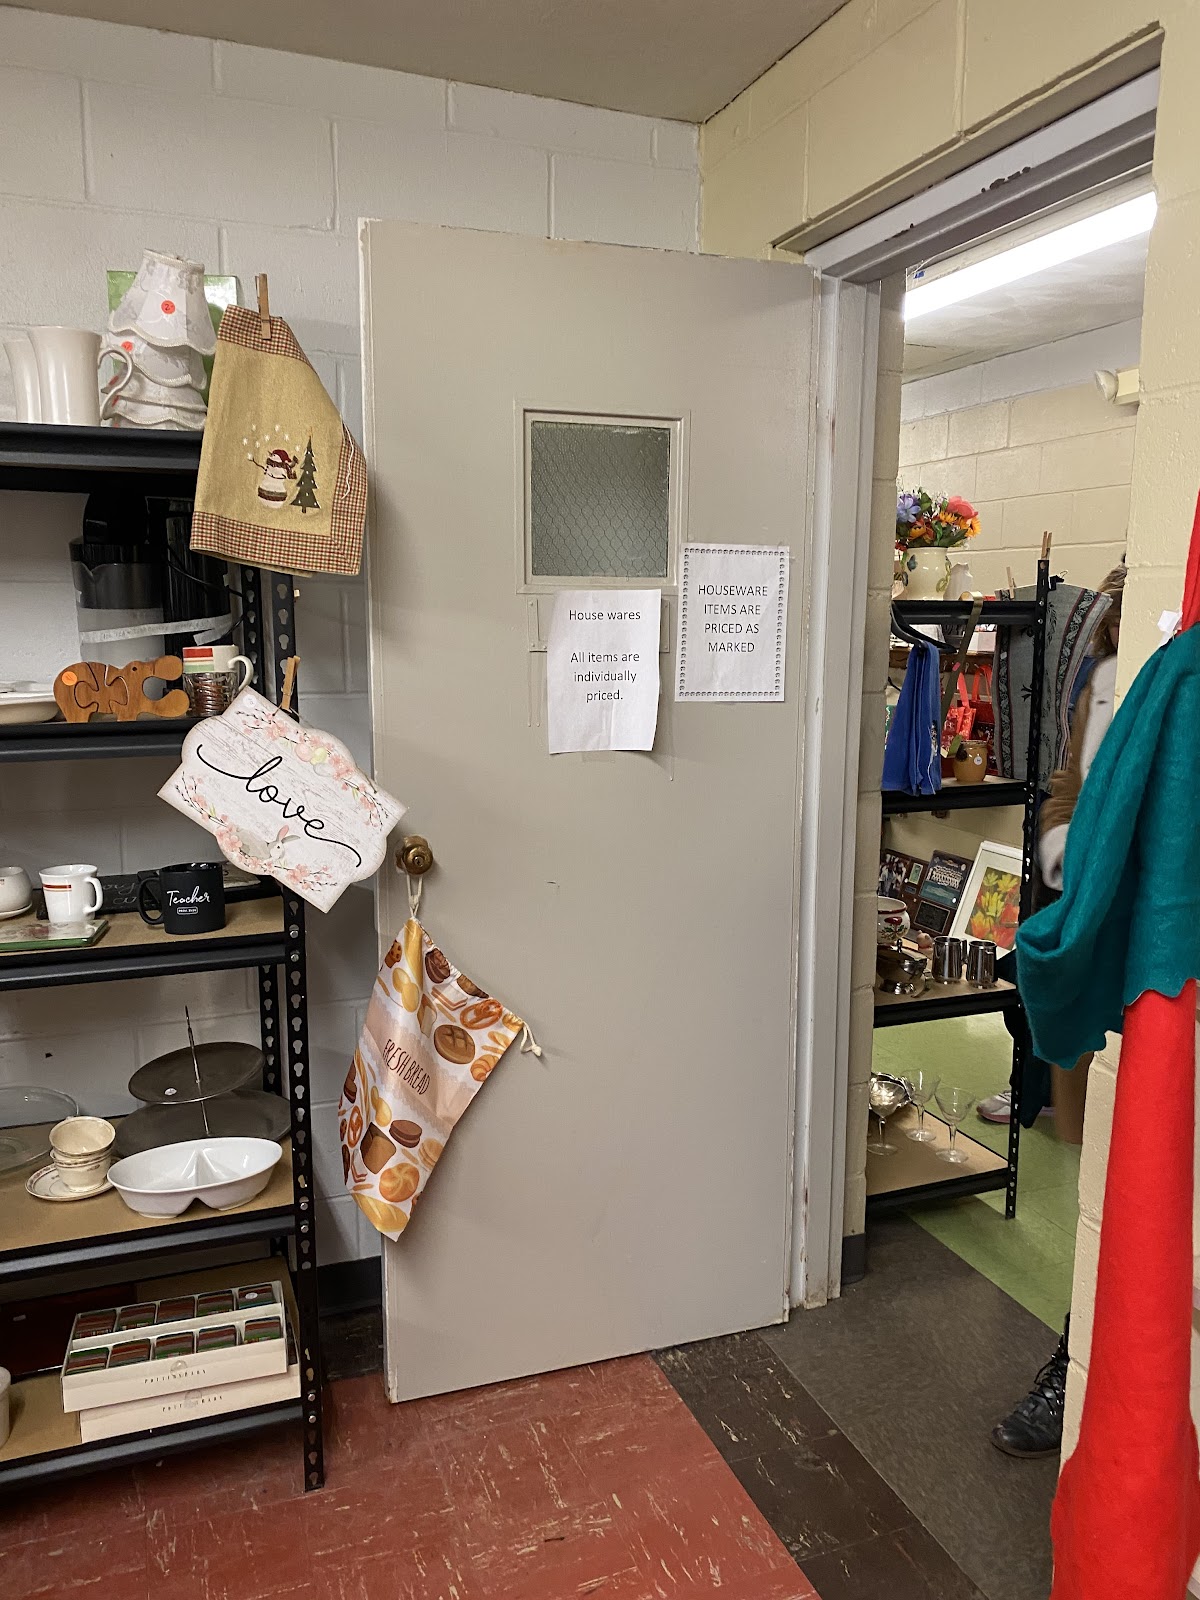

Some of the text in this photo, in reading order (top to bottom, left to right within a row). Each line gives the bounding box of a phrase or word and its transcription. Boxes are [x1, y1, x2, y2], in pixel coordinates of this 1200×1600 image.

[698, 584, 768, 597] HOUSEWARE
[569, 609, 641, 621] House wares
[704, 603, 761, 616] ITEMS ARE
[704, 622, 760, 635] PRICED AS
[707, 641, 755, 653] MARKED
[570, 651, 640, 663] All items are
[573, 670, 637, 684] individually
[586, 689, 624, 703] priced.
[197, 744, 362, 868] love
[166, 885, 210, 906] Teacher
[382, 1039, 431, 1095] FRESH BREAD
